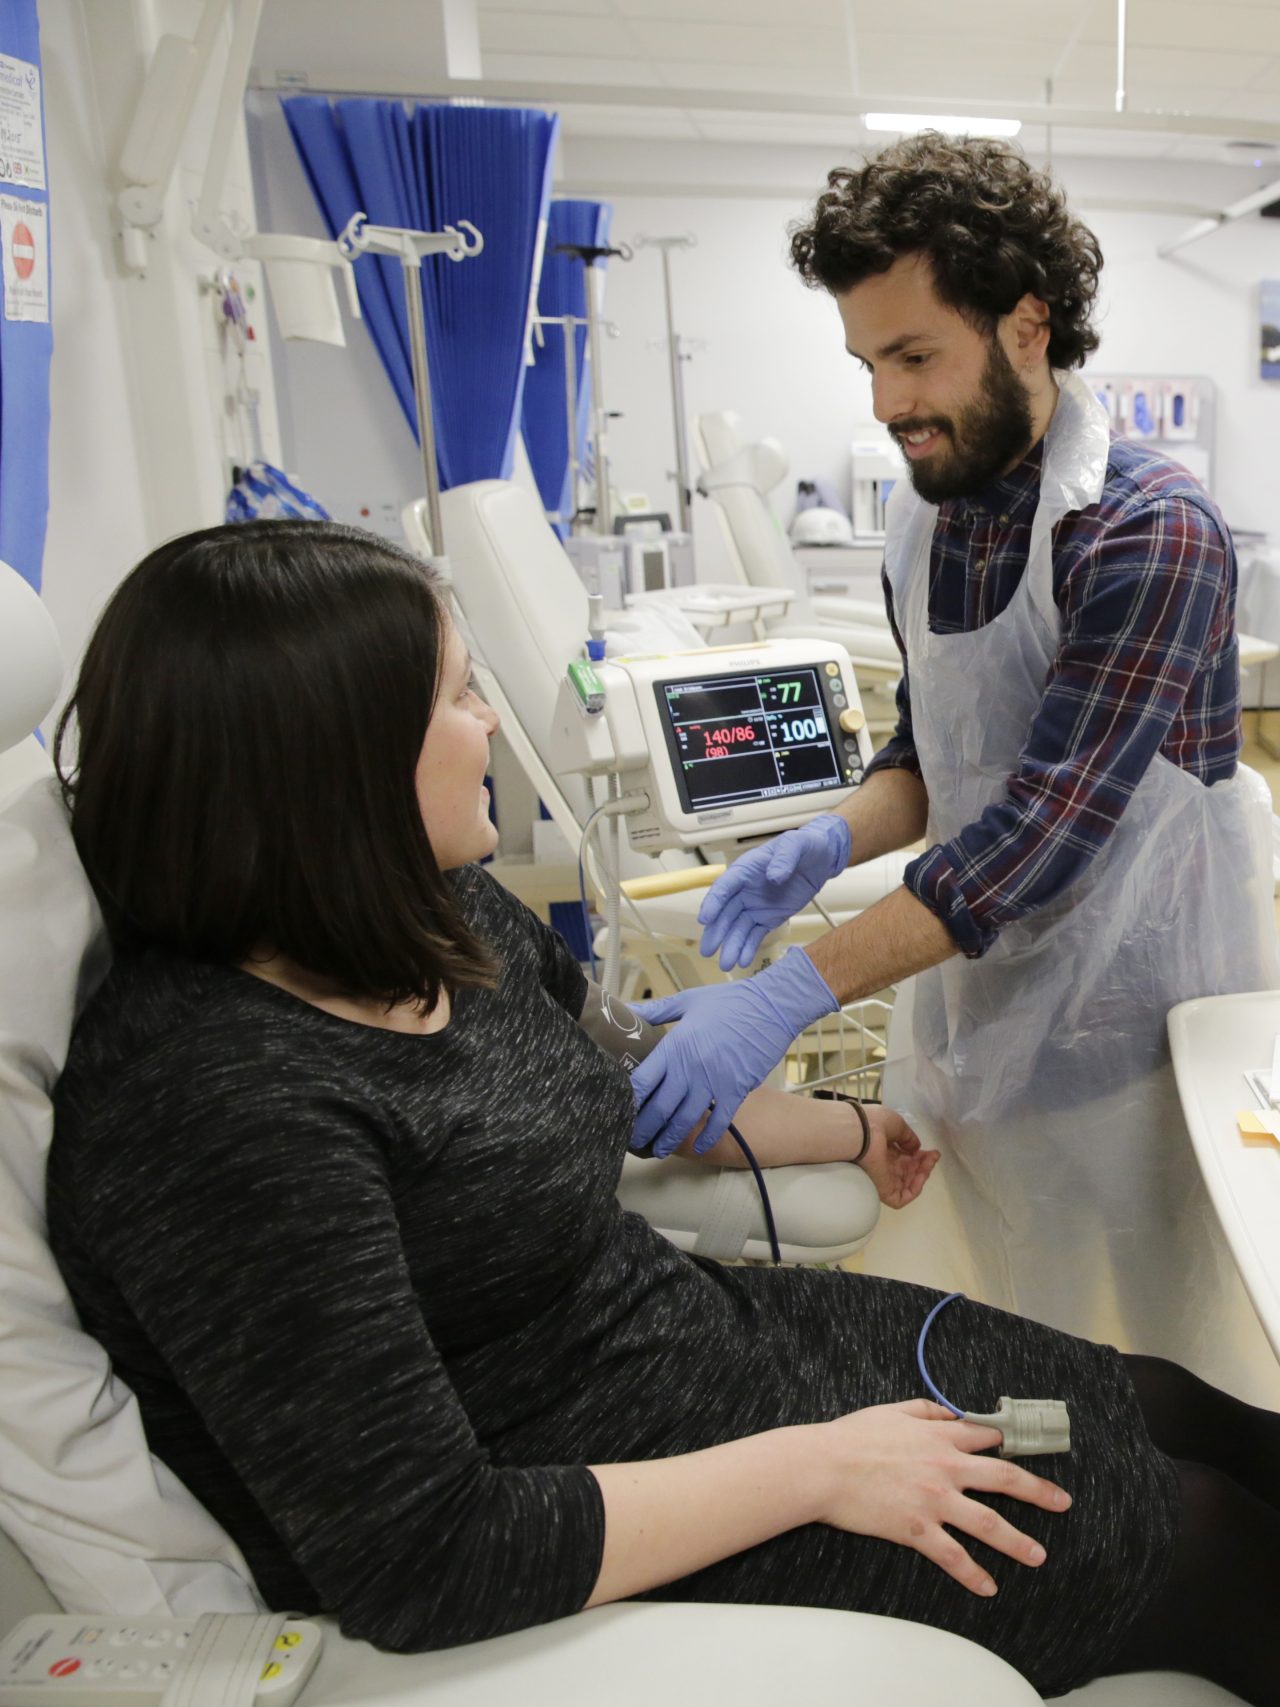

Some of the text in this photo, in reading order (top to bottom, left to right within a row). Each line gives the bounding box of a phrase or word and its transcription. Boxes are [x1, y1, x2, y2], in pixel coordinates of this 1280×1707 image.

[777, 682, 802, 704] 77
[703, 725, 756, 747] 140/86
[780, 718, 818, 743] 100
[705, 746, 729, 759] (98)
